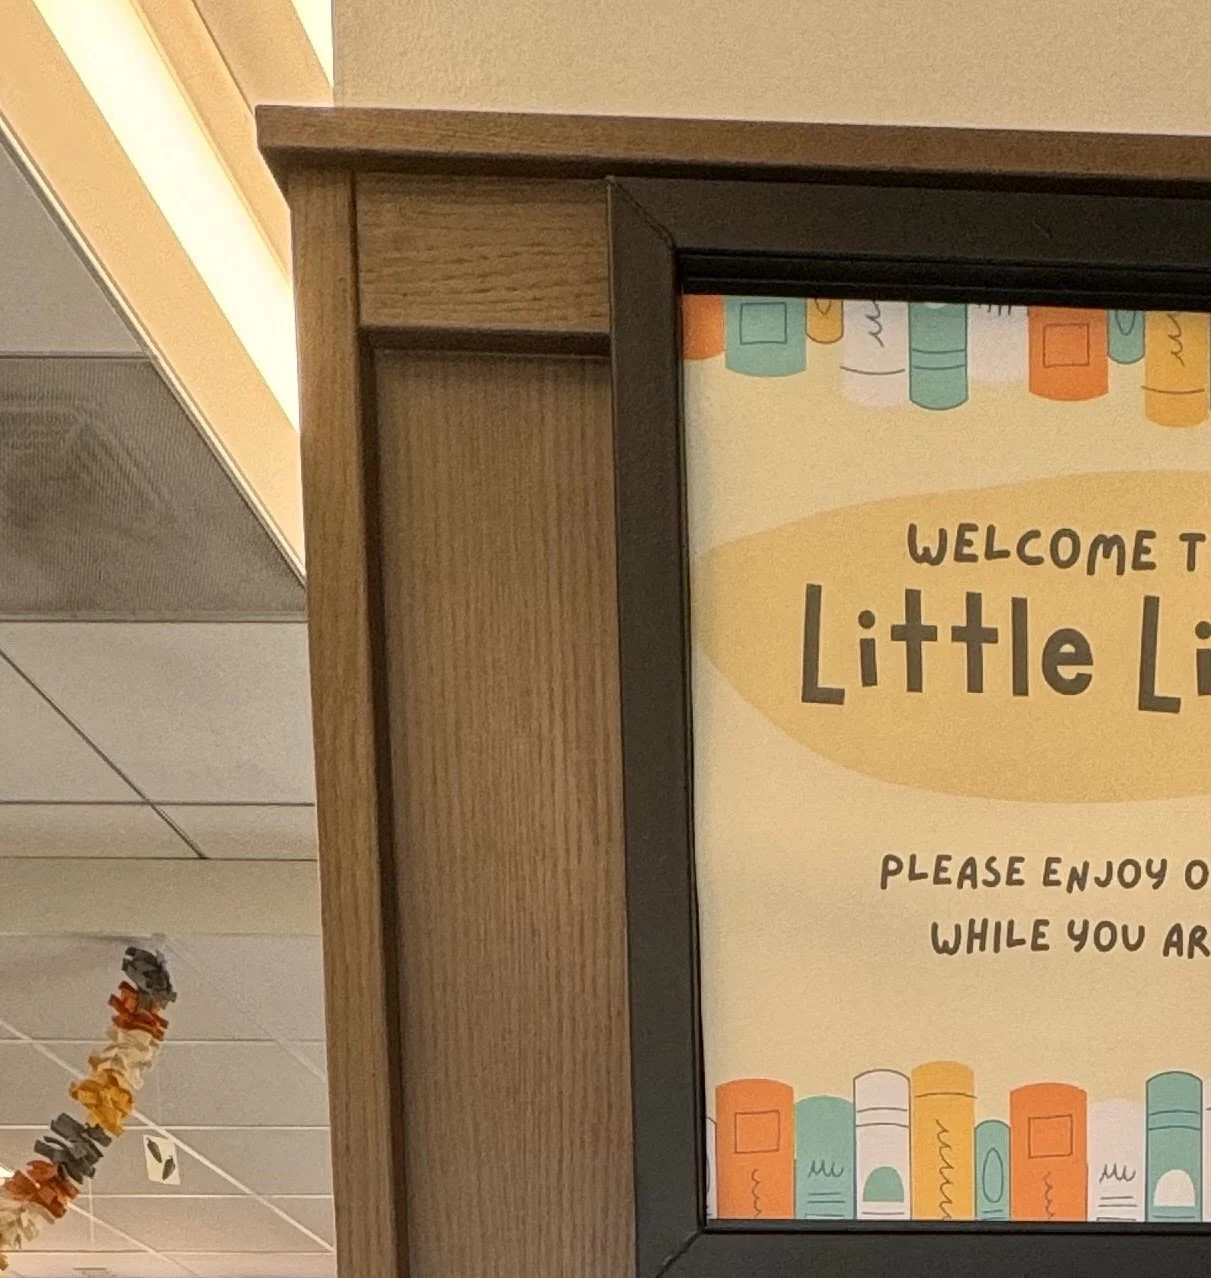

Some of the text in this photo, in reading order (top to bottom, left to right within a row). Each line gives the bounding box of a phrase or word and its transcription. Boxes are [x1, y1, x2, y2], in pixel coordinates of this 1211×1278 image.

[908, 524, 1157, 575] WELCOME
[800, 584, 1094, 706] Little
[881, 854, 1025, 890] PLEASE
[1042, 858, 1167, 893] ENJOY
[932, 920, 1049, 956] WHILE
[1066, 921, 1145, 954] YOU
